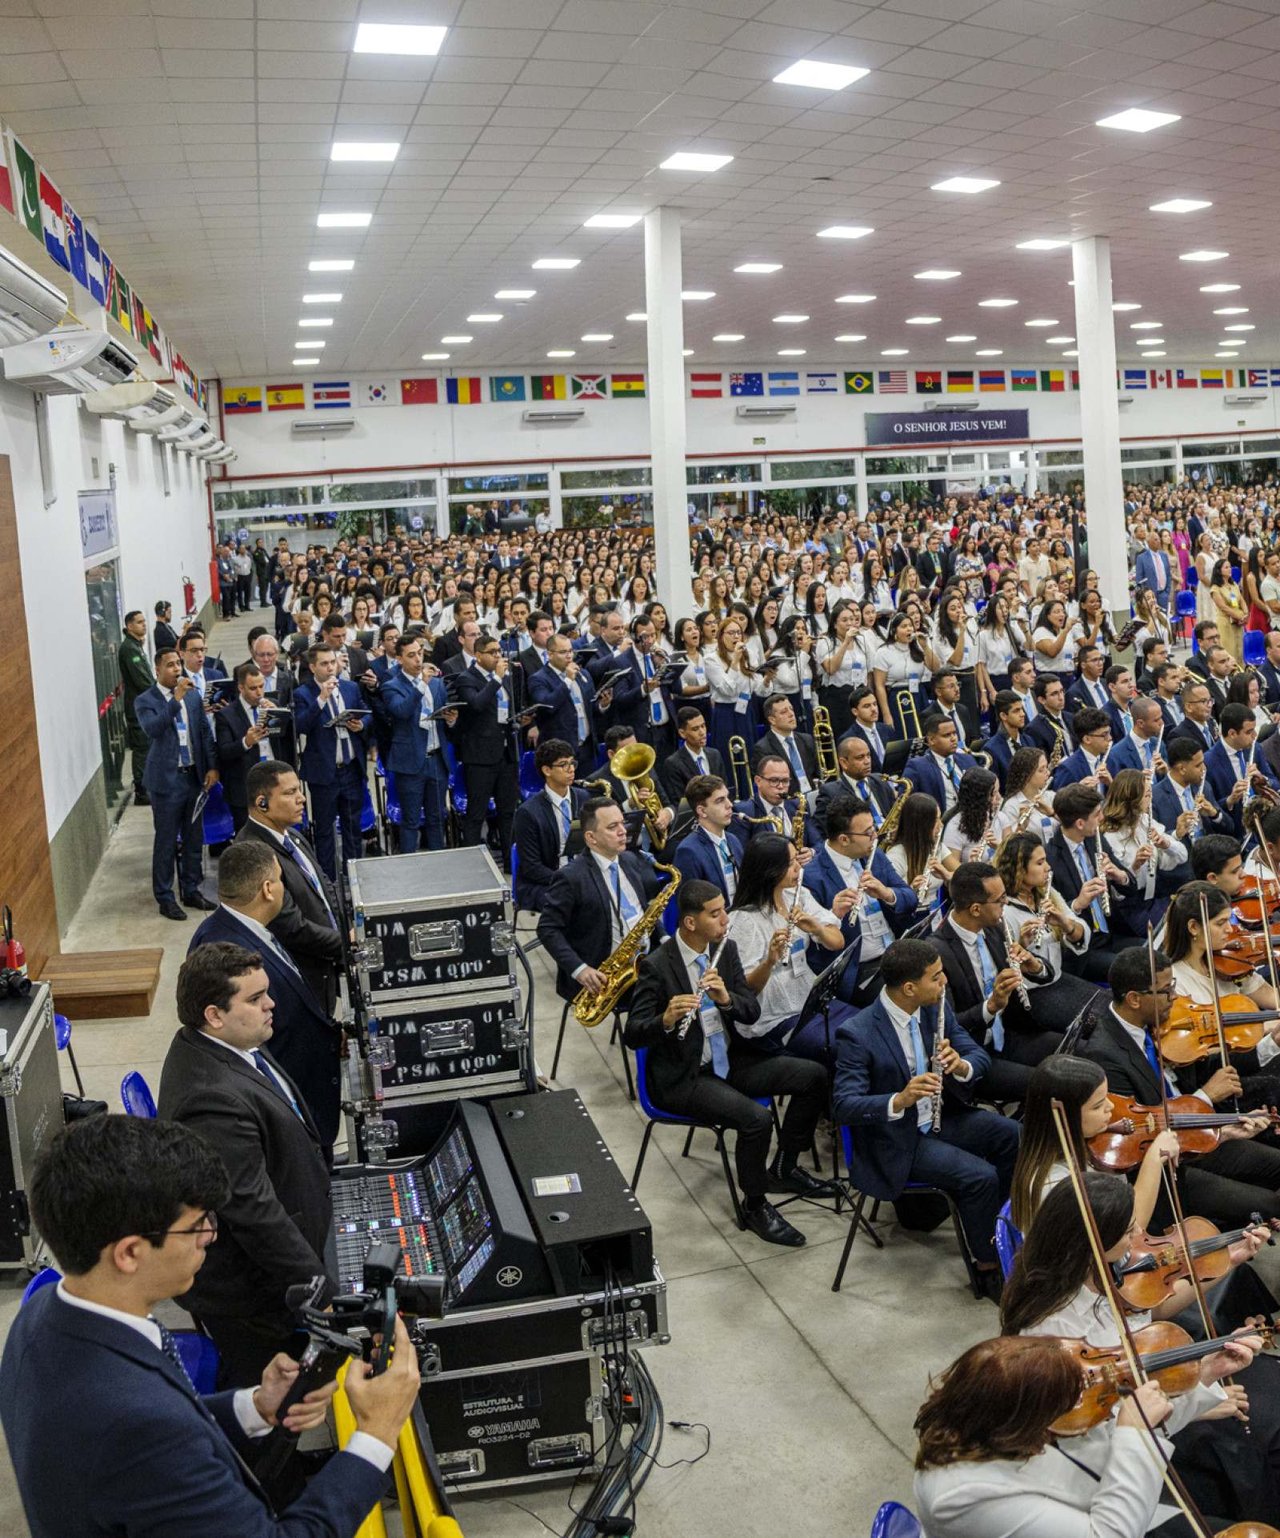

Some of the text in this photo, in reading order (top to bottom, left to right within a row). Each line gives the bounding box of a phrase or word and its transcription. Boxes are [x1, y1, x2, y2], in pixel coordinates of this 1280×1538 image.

[894, 420, 1007, 433] O SENHOR JESUS VEM!
[375, 911, 492, 937] DM 02
[383, 959, 484, 984] PSM 1000
[388, 1009, 503, 1036] DM 01
[397, 1054, 497, 1080] PSM 1000
[463, 1397, 513, 1410] ESTRUTURA
[463, 1402, 525, 1417] AUDIOVISUAL
[485, 1418, 541, 1436] YAMAHA
